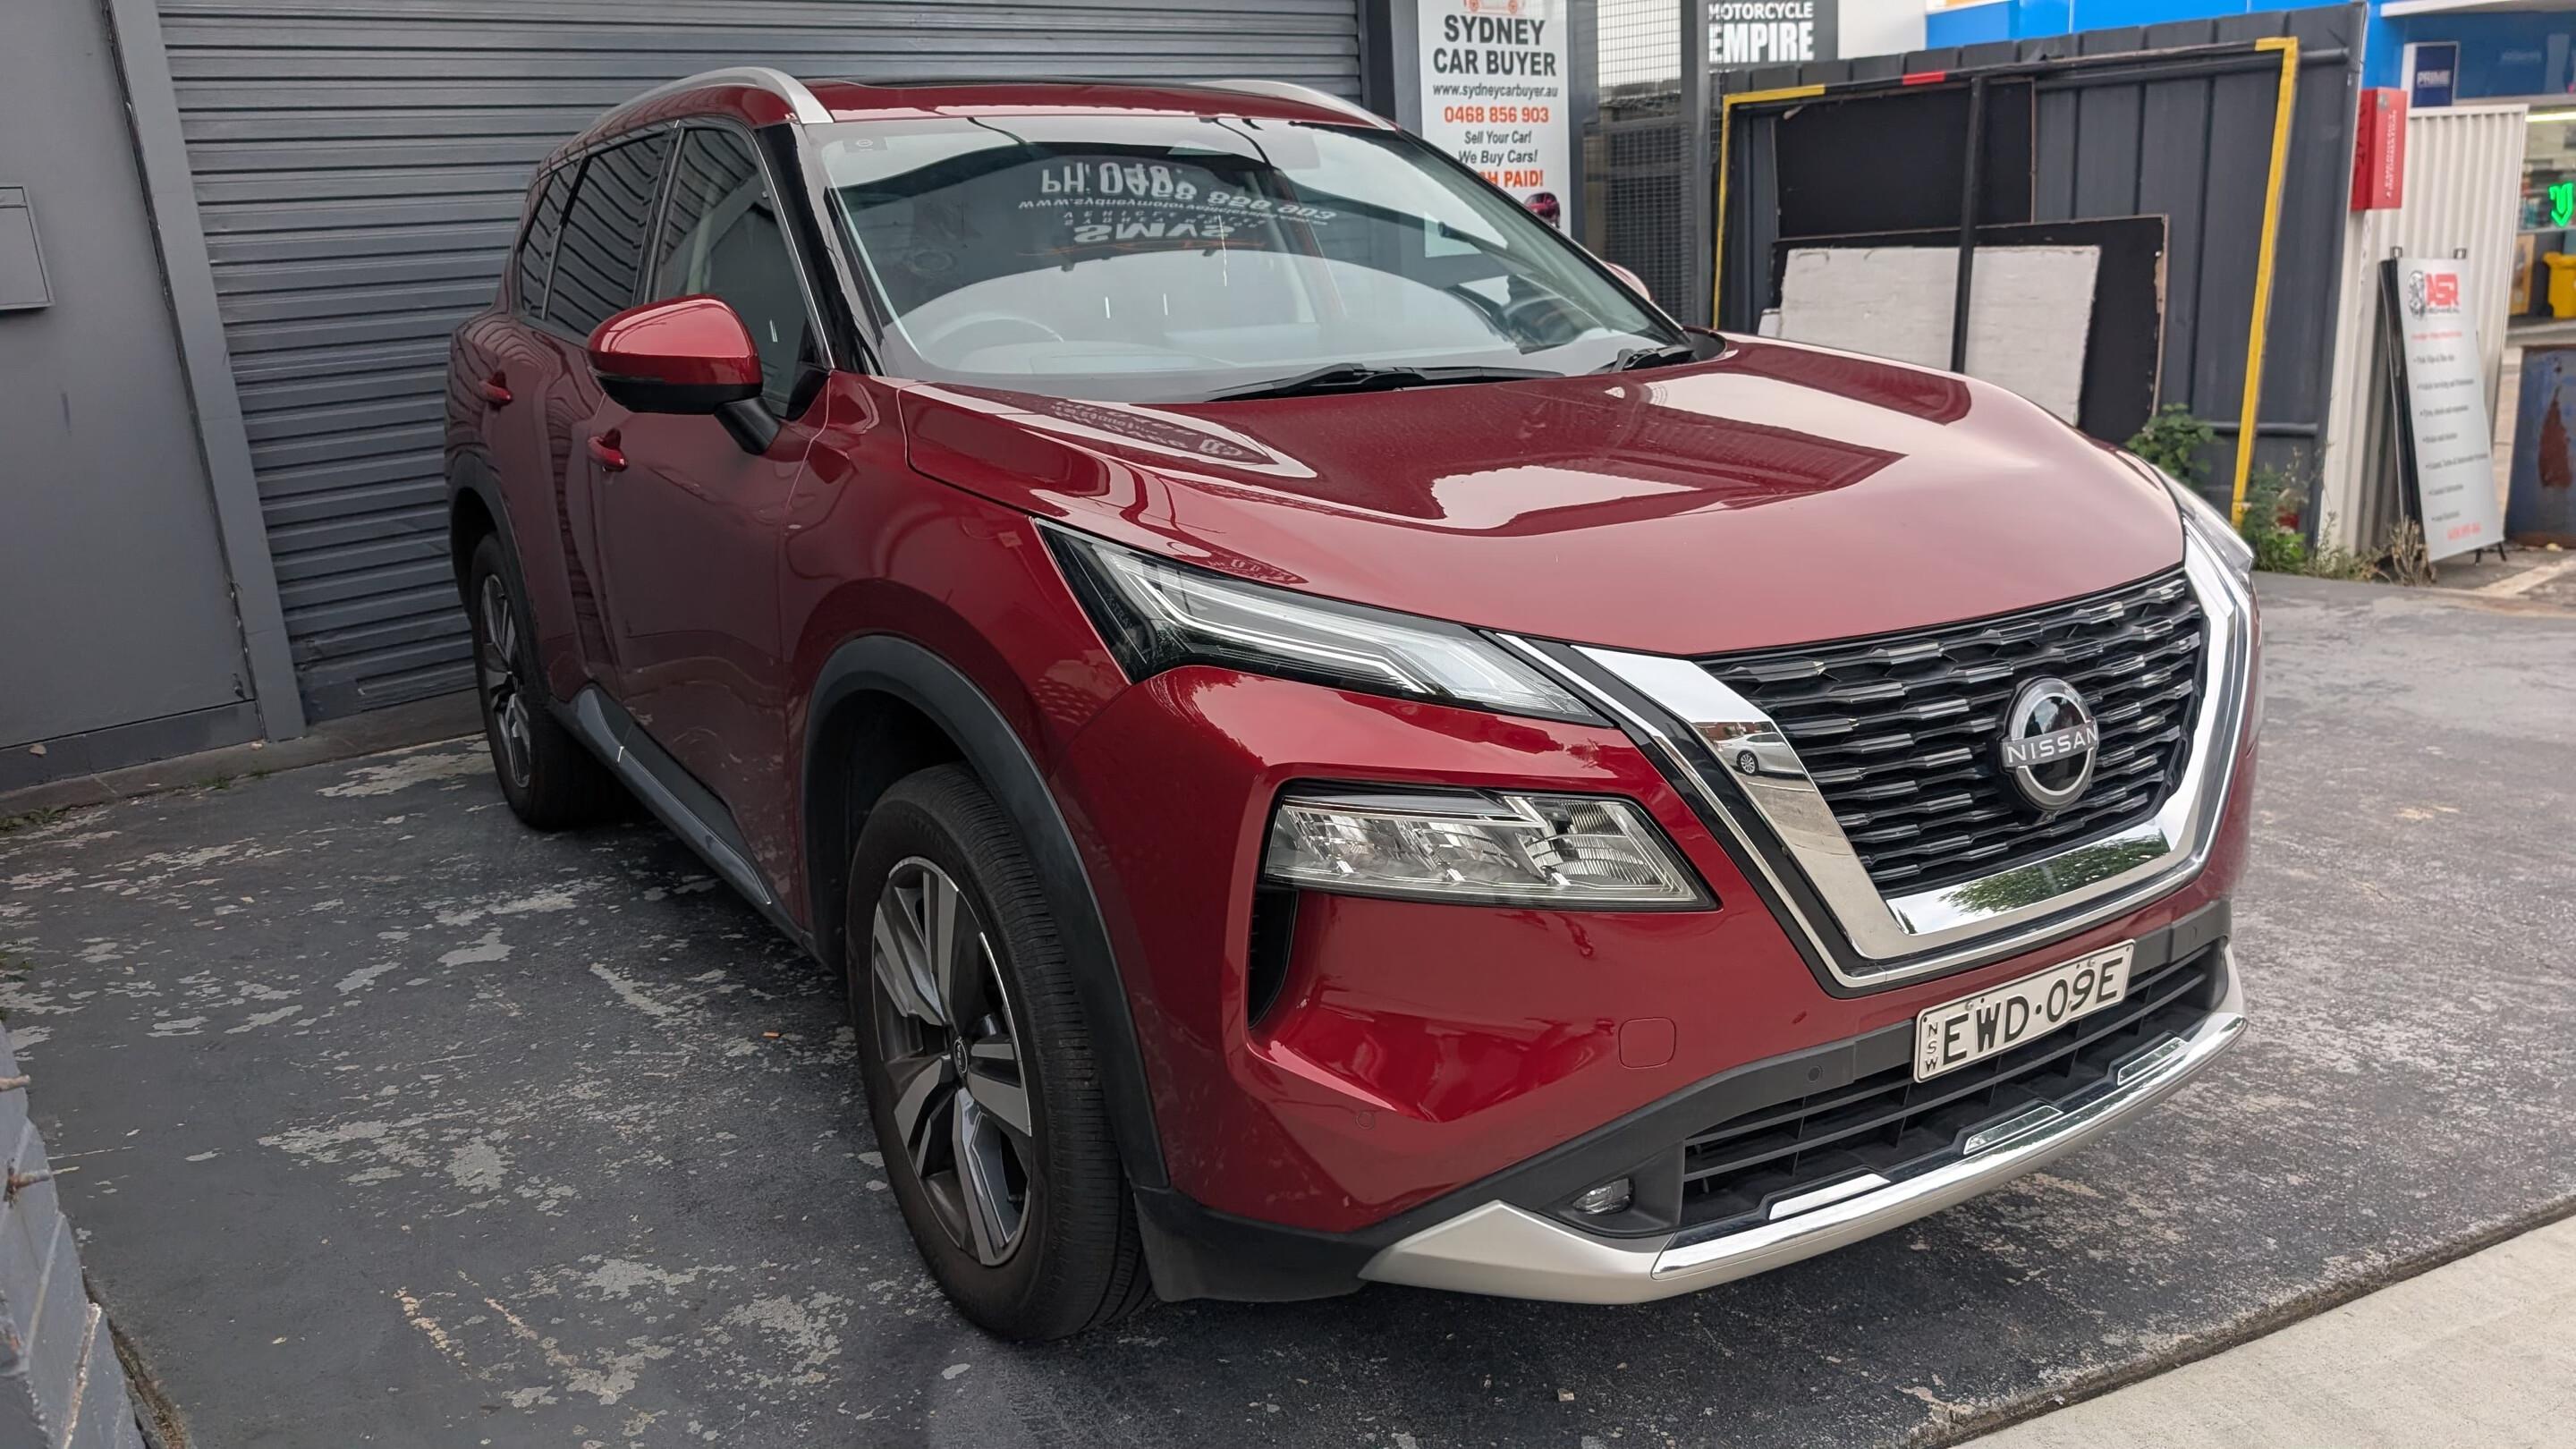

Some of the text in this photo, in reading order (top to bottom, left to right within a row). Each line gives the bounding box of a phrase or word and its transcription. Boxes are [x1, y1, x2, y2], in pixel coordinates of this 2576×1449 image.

[1707, 2, 1814, 20] MOTORCYCLE
[1444, 14, 1546, 46] SYDNEY
[1707, 21, 1815, 64] EMPIRE
[1433, 47, 1557, 76] CAR BUYER
[1432, 81, 1559, 100] www.sydneycarbuyer.au
[1444, 106, 1549, 123] 0468 856 903
[1464, 130, 1532, 144] Sell Your Car!
[1459, 149, 1538, 167] We Buy Cars!
[1504, 170, 1544, 187] PAID!
[2006, 724, 2097, 763] NISSAN
[1925, 1021, 1939, 1072] NSW
